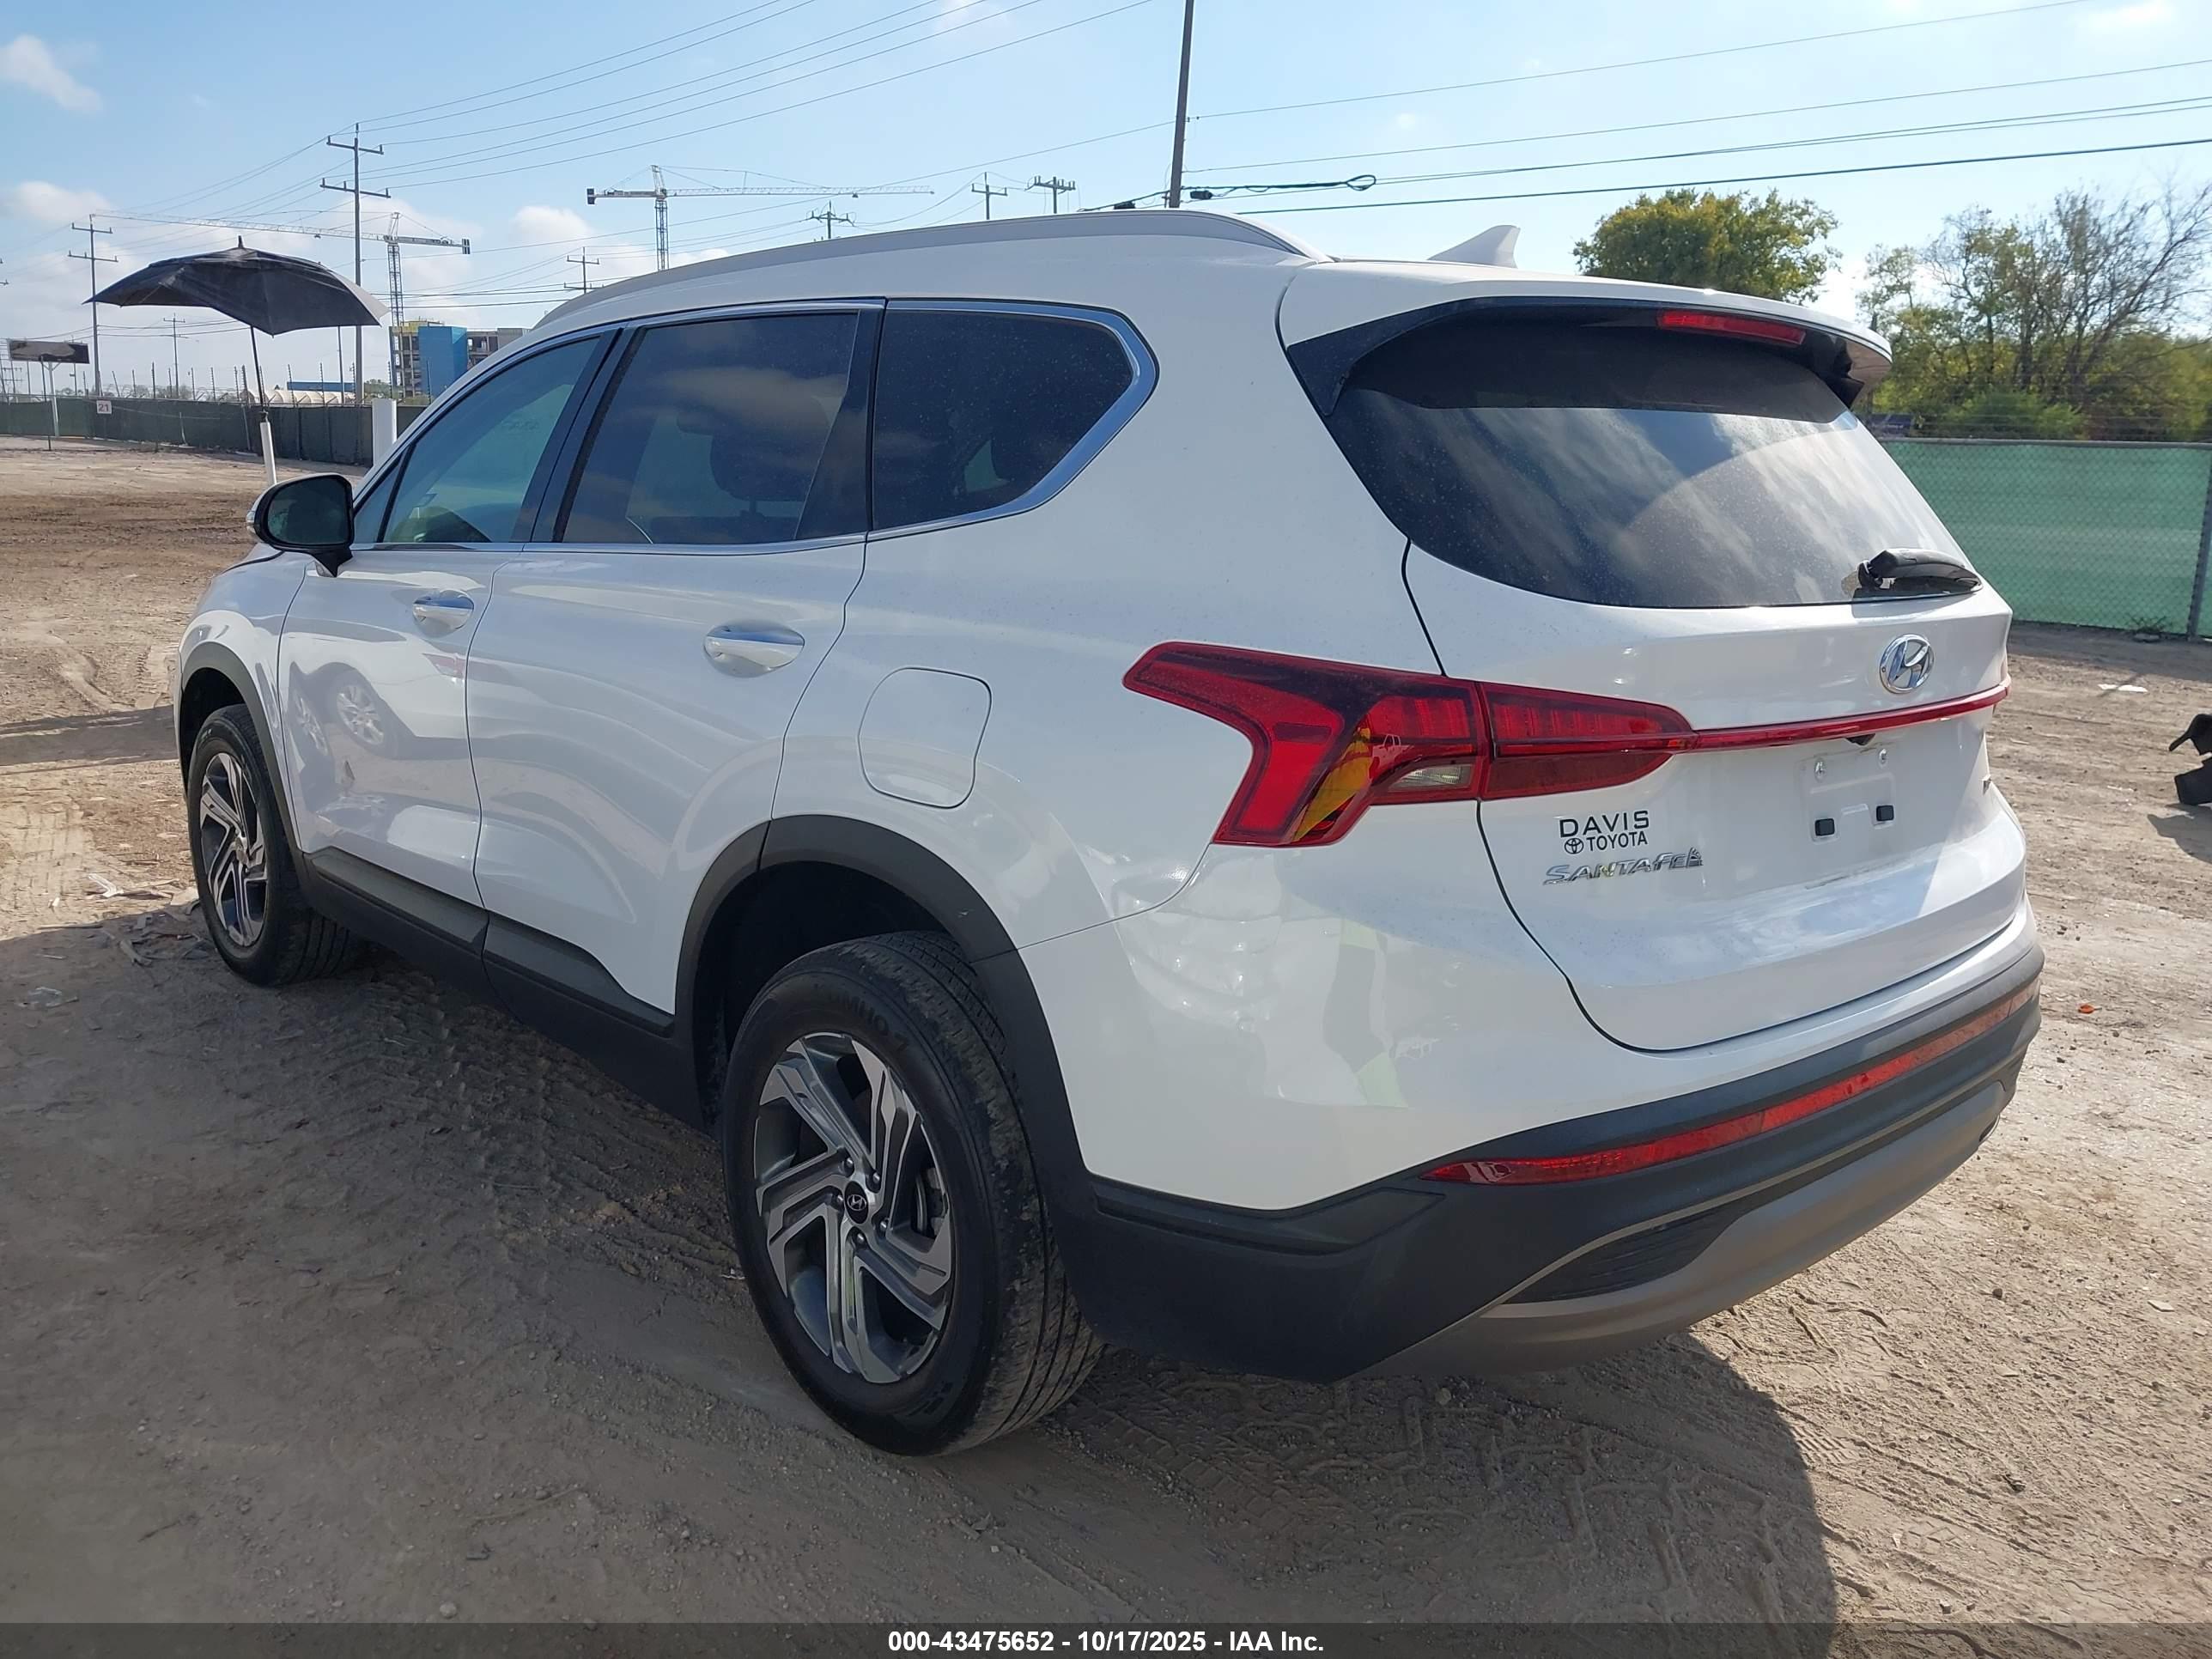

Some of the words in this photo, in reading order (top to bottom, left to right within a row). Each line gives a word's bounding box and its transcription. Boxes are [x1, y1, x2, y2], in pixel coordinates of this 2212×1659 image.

[98, 404, 109, 412] 21
[1559, 810, 1650, 838] DAVIS
[1586, 831, 1648, 852] TOYOTA
